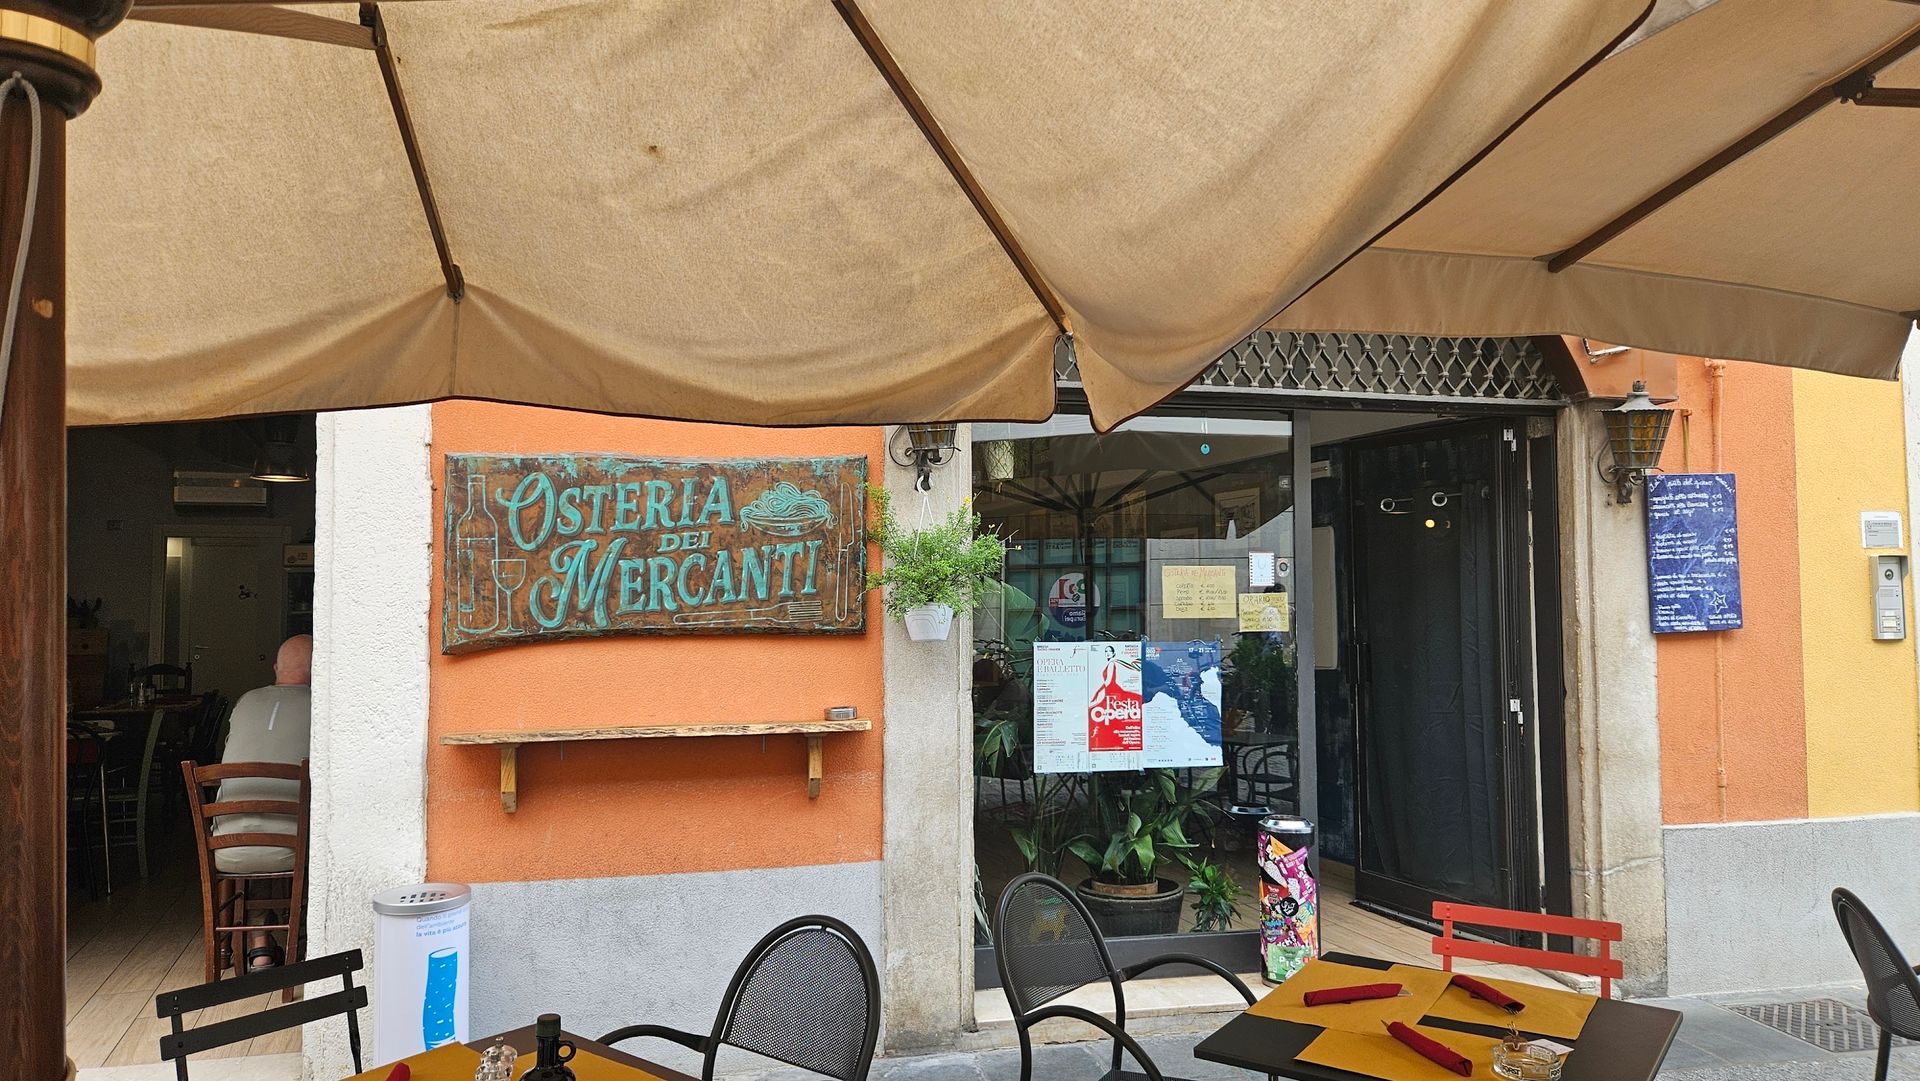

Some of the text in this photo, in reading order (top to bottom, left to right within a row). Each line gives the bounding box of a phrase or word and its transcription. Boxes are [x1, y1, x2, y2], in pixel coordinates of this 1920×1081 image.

[495, 472, 735, 551] OSTERIA
[657, 530, 713, 553] DEI
[529, 537, 823, 628] MERCANTI
[1036, 658, 1064, 666] OPERA
[1043, 665, 1086, 673] BALLETTO
[1106, 695, 1139, 710] Festa
[1090, 706, 1140, 726] Opera
[424, 929, 436, 937] vita
